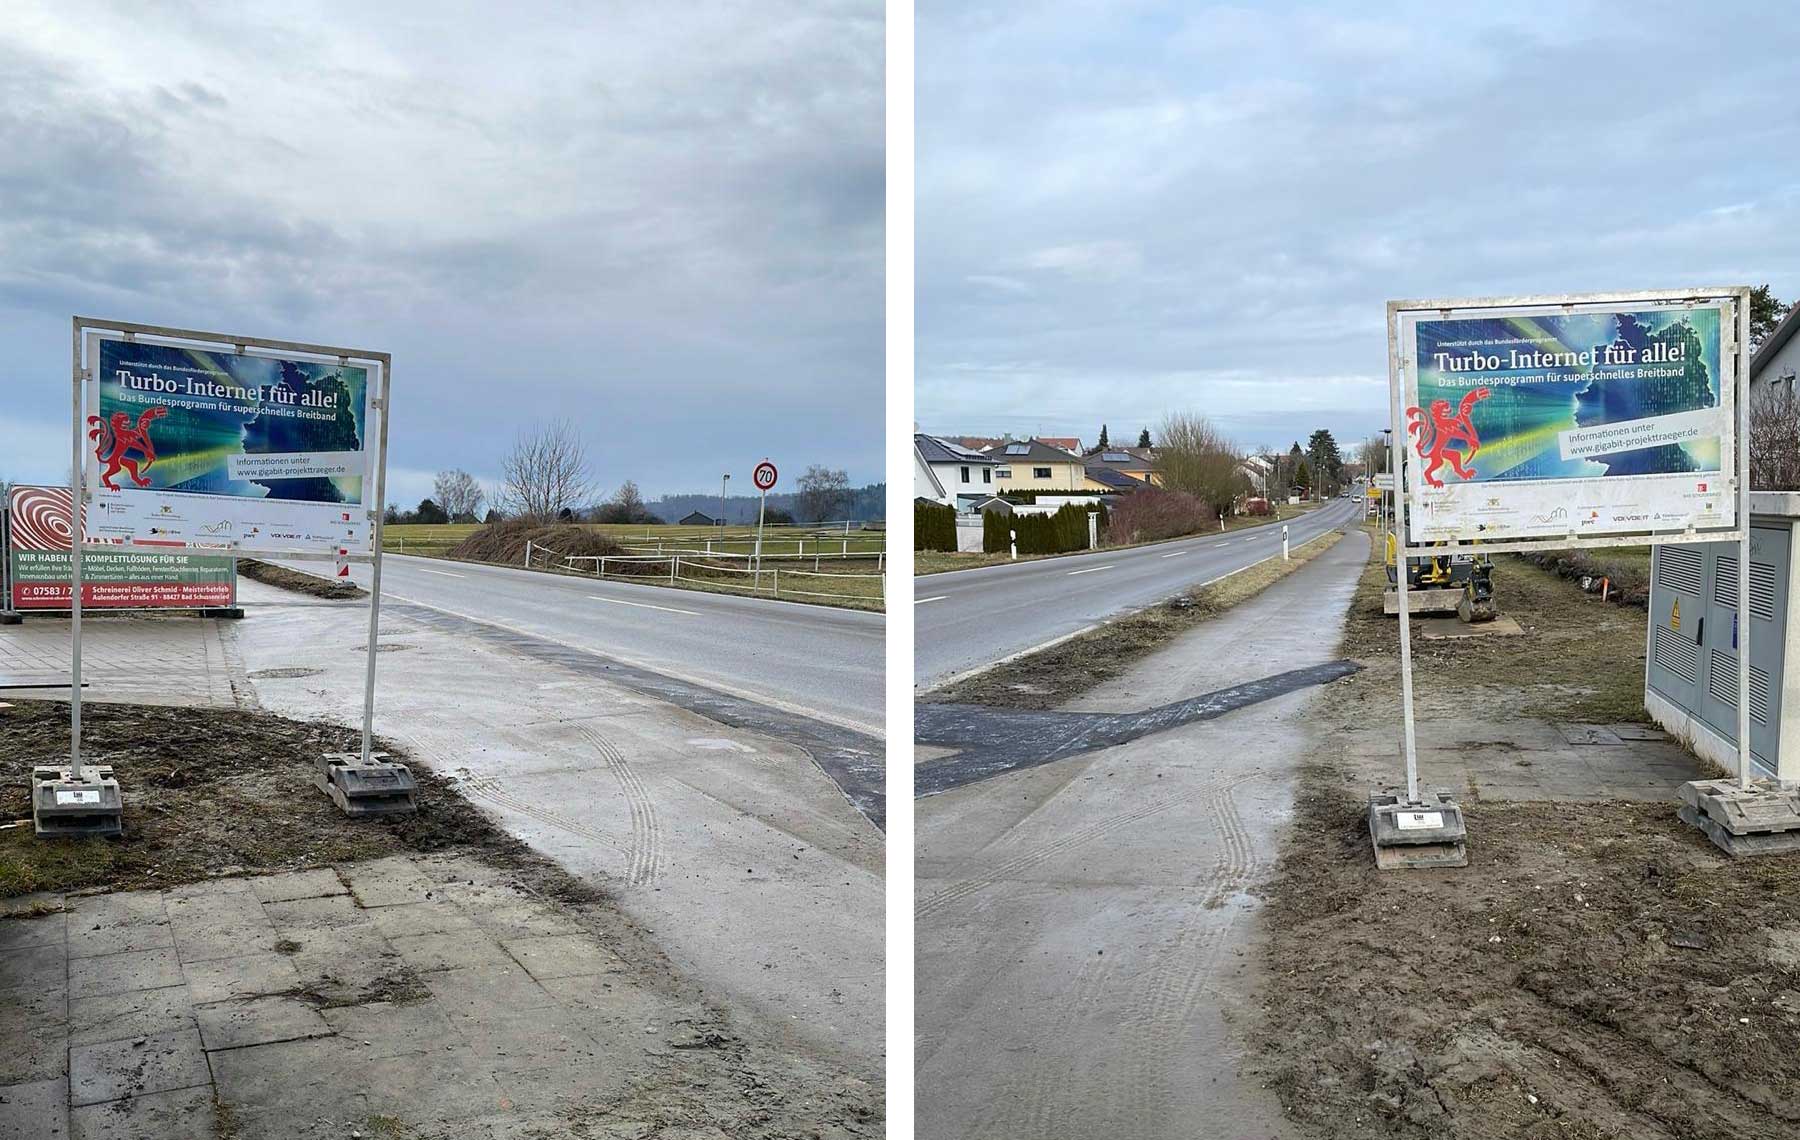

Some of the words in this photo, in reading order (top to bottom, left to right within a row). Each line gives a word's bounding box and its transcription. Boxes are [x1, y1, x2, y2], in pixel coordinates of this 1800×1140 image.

[1433, 347, 1599, 373] Turbo-Internet
[1604, 344, 1637, 365] für
[1641, 342, 1686, 364] alle!
[1438, 377, 1456, 387] Das
[1458, 375, 1544, 387] Bundesprogramm
[1546, 372, 1560, 382] für
[1562, 369, 1635, 383] superschnelles
[1637, 366, 1684, 379] Breitband
[116, 370, 265, 402] Turbo-Internet
[269, 385, 297, 404] für
[301, 390, 338, 408] alle!
[119, 393, 137, 402] Das
[138, 394, 217, 409] Bundesprogramm
[219, 401, 231, 411] für
[233, 404, 295, 417] superschnelles
[297, 410, 337, 421] Breitband
[1569, 427, 1630, 443] Informationen
[1631, 424, 1655, 434] unter
[1570, 428, 1698, 455] www.gigabit-projekttraeger.de
[236, 457, 289, 466] Informationen
[290, 457, 310, 465] unter
[238, 465, 346, 477] www.gigabit-projekttraeger.de
[759, 469, 773, 483] 70
[18, 553, 36, 562] WIR
[38, 554, 68, 562] HABEN
[85, 554, 159, 564] KOMPLETTLÖSUNG
[159, 554, 175, 564] FÜR
[176, 556, 189, 564] SIE
[33, 587, 60, 595] 07583
